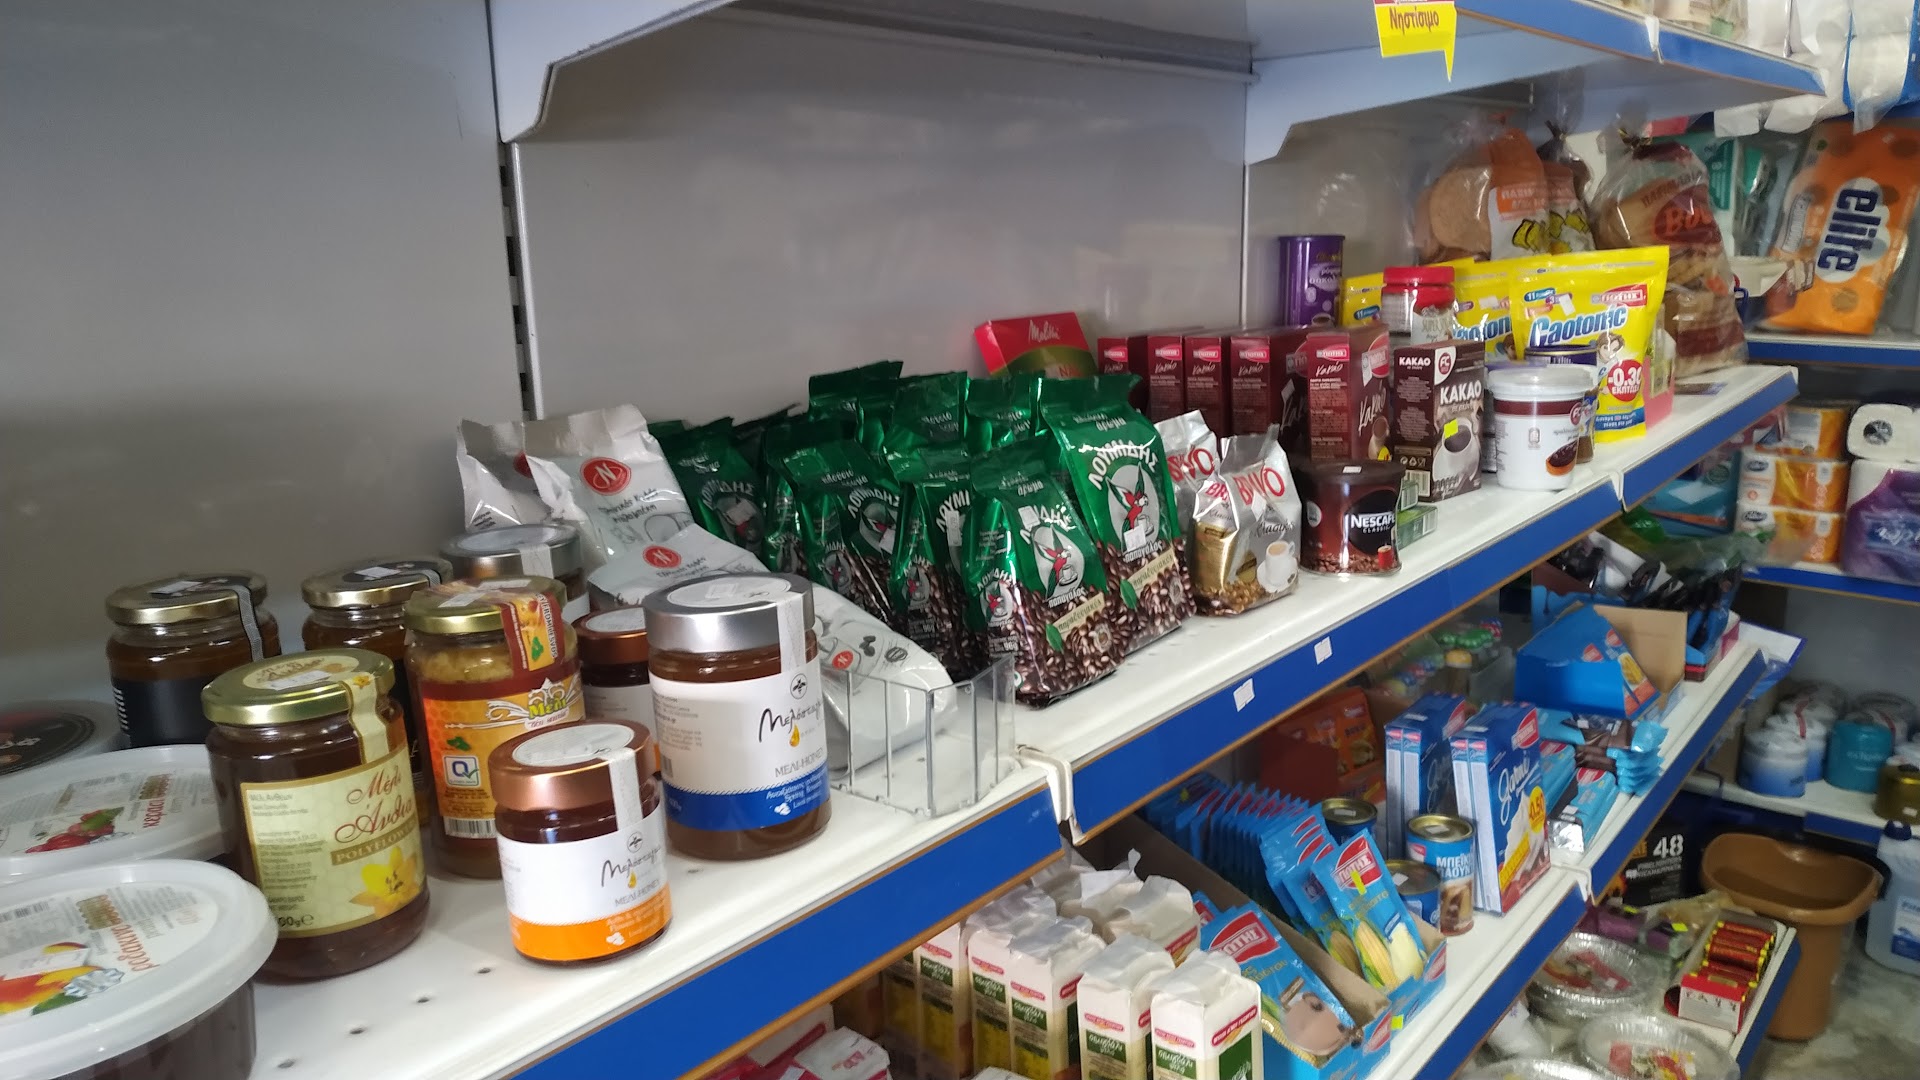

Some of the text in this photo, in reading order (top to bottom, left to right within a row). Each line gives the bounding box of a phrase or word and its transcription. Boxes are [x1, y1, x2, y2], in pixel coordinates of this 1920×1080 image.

[1389, 6, 1440, 35] Νηστίσιμο
[1817, 189, 1882, 272] elite
[1528, 306, 1628, 347] Caotonic
[1399, 356, 1431, 367] KAKAO
[1440, 379, 1482, 405] KAKAO
[1088, 439, 1160, 491] ΛΟΥΜΙΔΗΣ
[1122, 539, 1164, 564] παπαγάλος
[1048, 586, 1087, 608] παπαγάλος
[1653, 833, 1684, 858] 48
